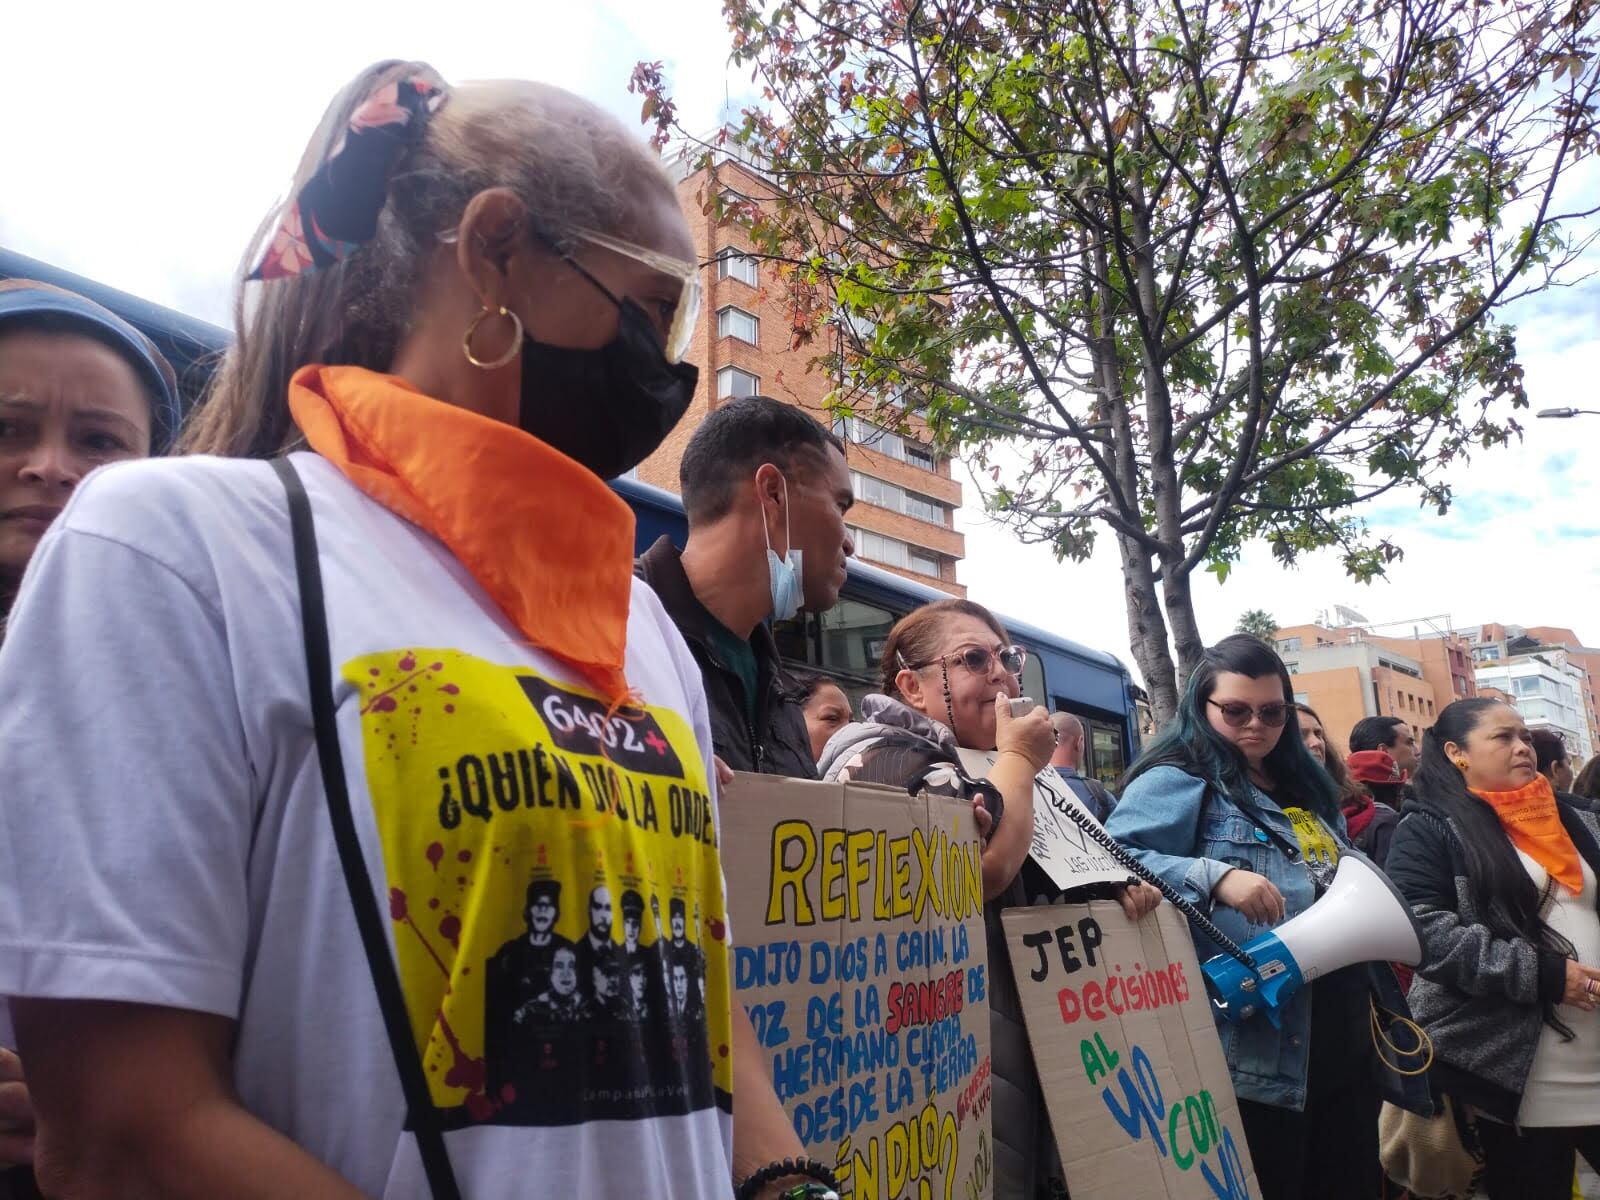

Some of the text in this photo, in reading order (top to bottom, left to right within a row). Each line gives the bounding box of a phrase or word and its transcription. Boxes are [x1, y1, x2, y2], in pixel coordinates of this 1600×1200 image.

[438, 743, 581, 829] ¿QUIÉN
[626, 775, 659, 832] LA
[668, 784, 718, 848] ORDE
[765, 816, 982, 926] REFLEXIÓN
[734, 940, 800, 991] DIJO
[809, 936, 867, 985] DIOS
[874, 932, 888, 977] A
[952, 924, 969, 964] LA
[1023, 917, 1102, 982] JEP
[744, 964, 985, 1048] OZ DE LA SANGRE DE
[773, 1012, 961, 1102] HERMANO CLAMA
[794, 1033, 977, 1147] DESDE LA TIERRA
[1080, 1032, 1119, 1085] AL
